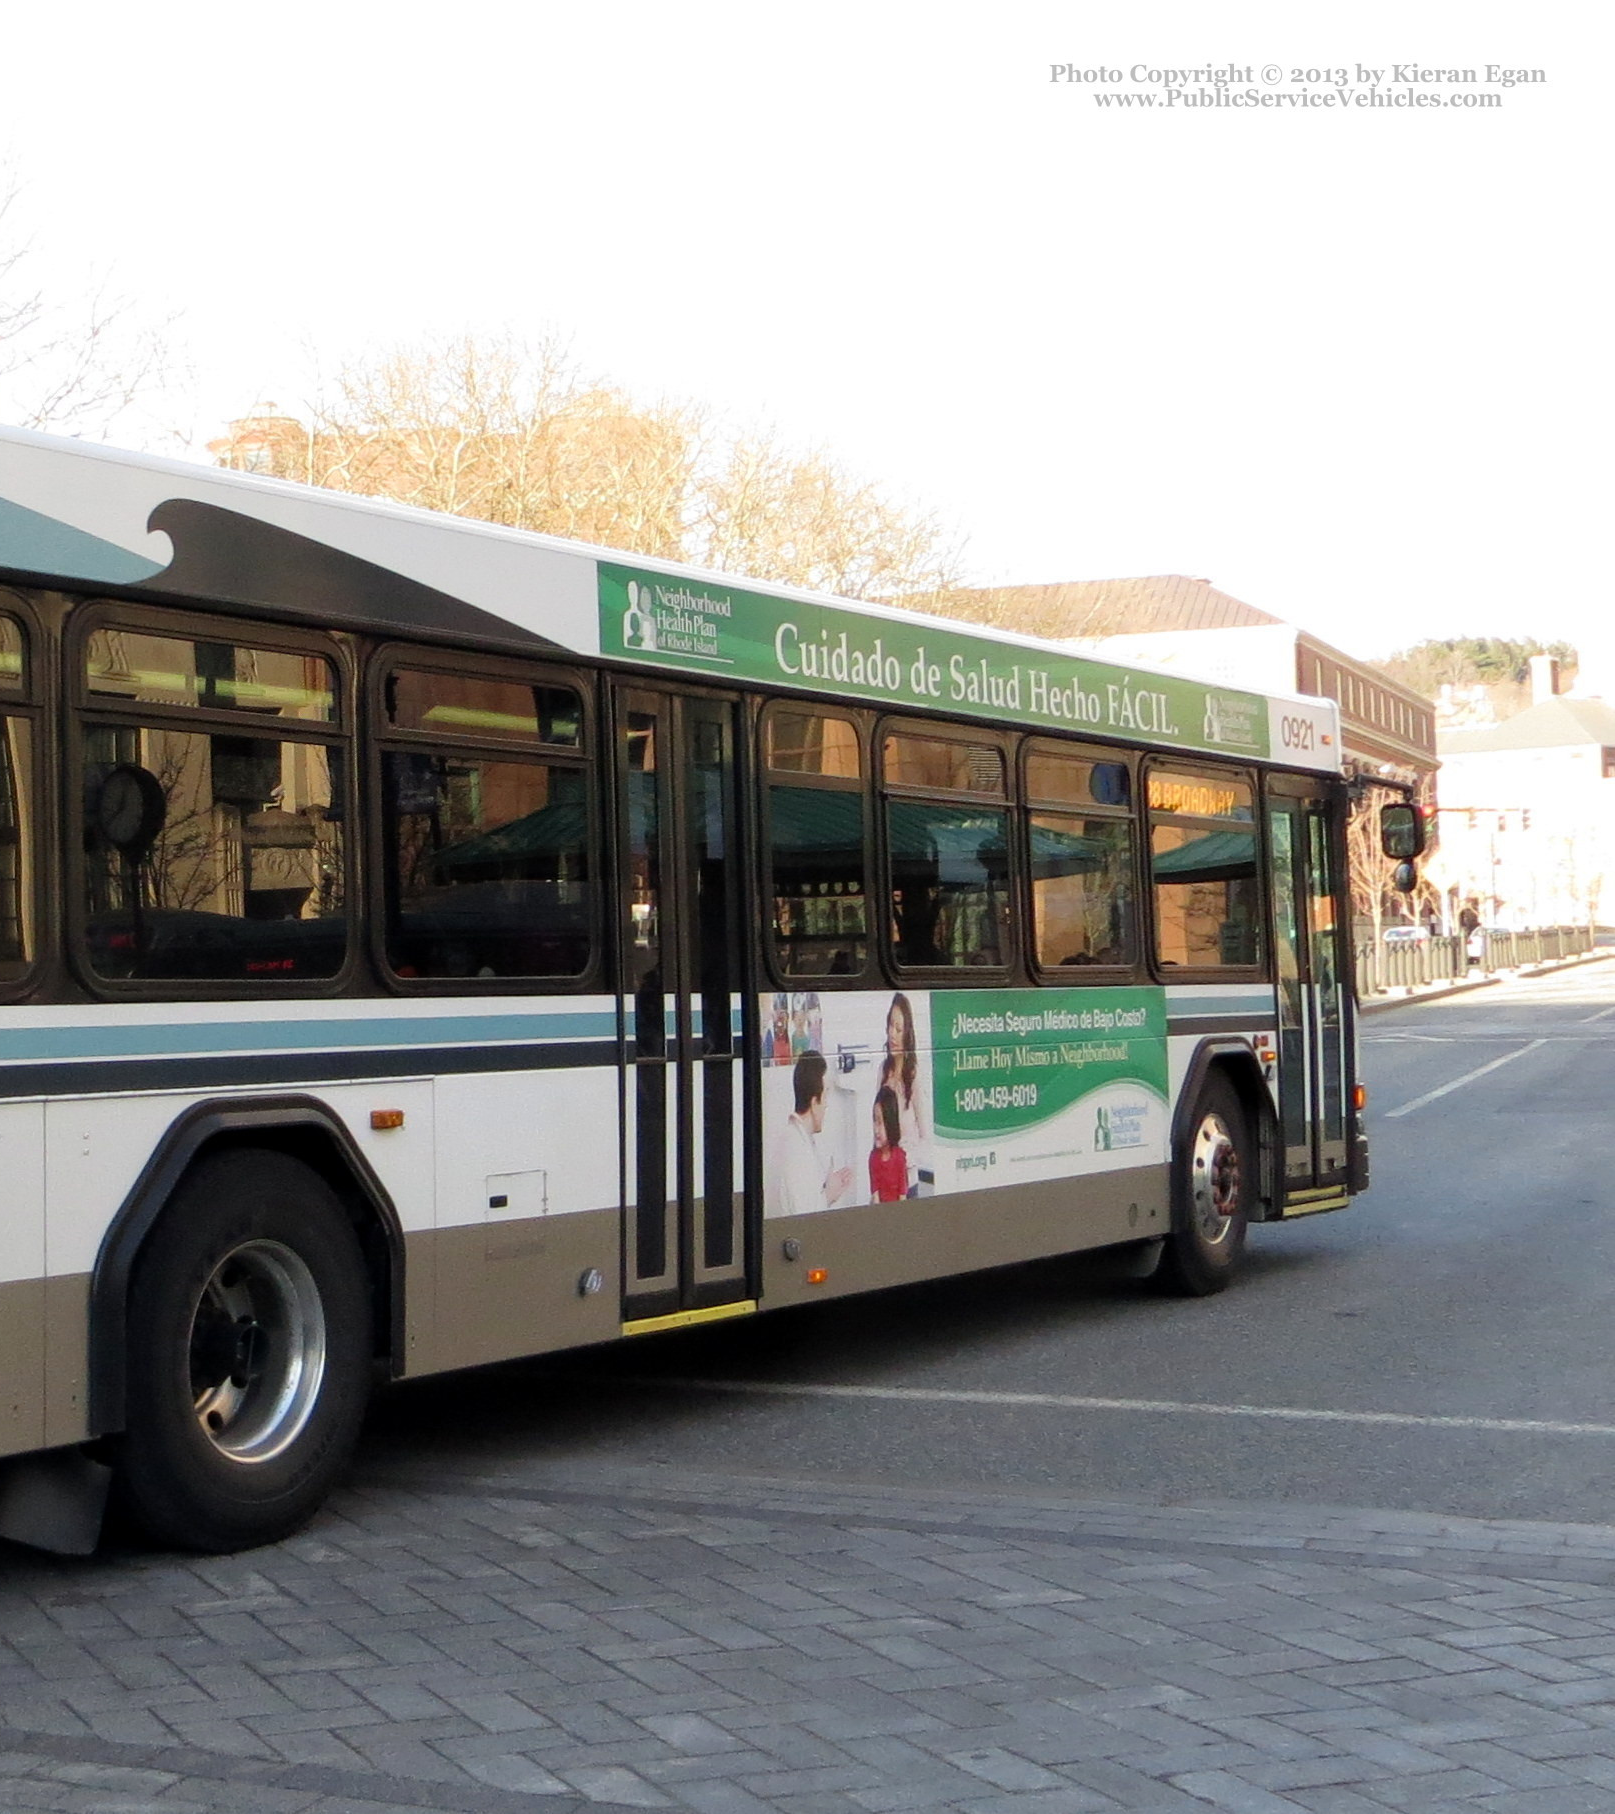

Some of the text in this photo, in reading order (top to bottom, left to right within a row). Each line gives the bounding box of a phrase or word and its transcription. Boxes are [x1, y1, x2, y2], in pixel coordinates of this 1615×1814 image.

[653, 584, 732, 618] Neighborhood
[656, 609, 717, 638] Health Plan
[667, 633, 693, 651] Rhode
[693, 636, 718, 655] Island
[775, 623, 901, 691] Cuidado
[910, 646, 941, 697] de
[950, 654, 1021, 711] Salud
[1027, 669, 1101, 723] Hecho
[1106, 674, 1179, 736] FÁCIL.
[1281, 715, 1316, 751] 0921
[1164, 783, 1237, 816] BROADWAY
[952, 1007, 1146, 1039] ¿Necesita Seguro Médico de Bajo Costo?
[953, 1041, 1129, 1077] ¡Llame Hoy Mismo a Neighborhood!
[955, 1084, 1037, 1112] 1-800-459-6019
